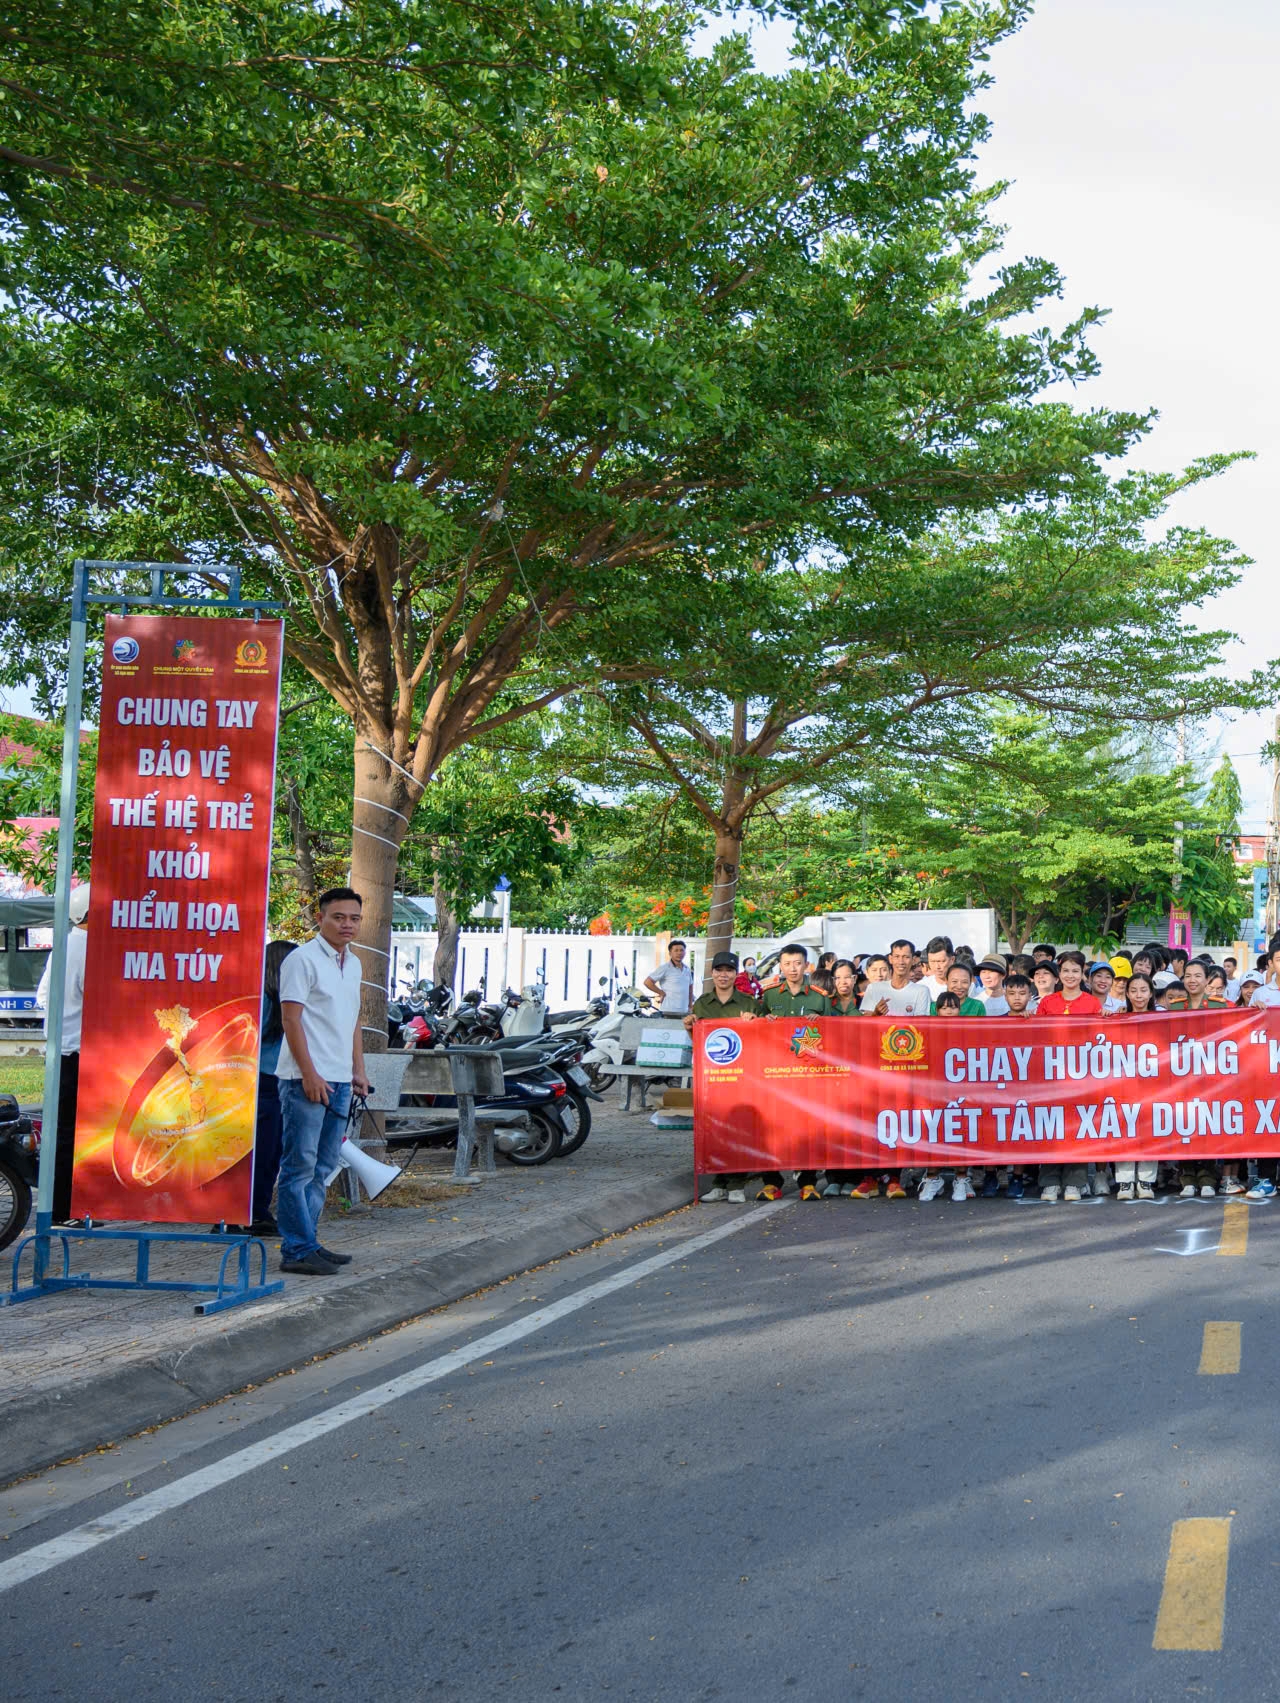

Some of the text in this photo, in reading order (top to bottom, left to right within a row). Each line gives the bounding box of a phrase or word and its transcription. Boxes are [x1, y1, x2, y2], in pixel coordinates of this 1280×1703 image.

[117, 697, 258, 728] CHUNG TAY
[138, 740, 231, 784] BẢO VỆ
[109, 791, 254, 834] THẾ HỆ TRẺ
[147, 842, 210, 879] KHỎI
[111, 890, 240, 937] HIỂM HỌA
[124, 947, 223, 982] MA TÚY
[944, 1047, 1033, 1089] CHẠY
[1044, 1033, 1159, 1080] HƯỞNG
[1169, 1034, 1239, 1076] ỨNG
[876, 1097, 982, 1149] QUYẾT
[991, 1099, 1065, 1142] TÂM
[1075, 1096, 1141, 1139] XÂY
[1152, 1097, 1244, 1144] DỰNG
